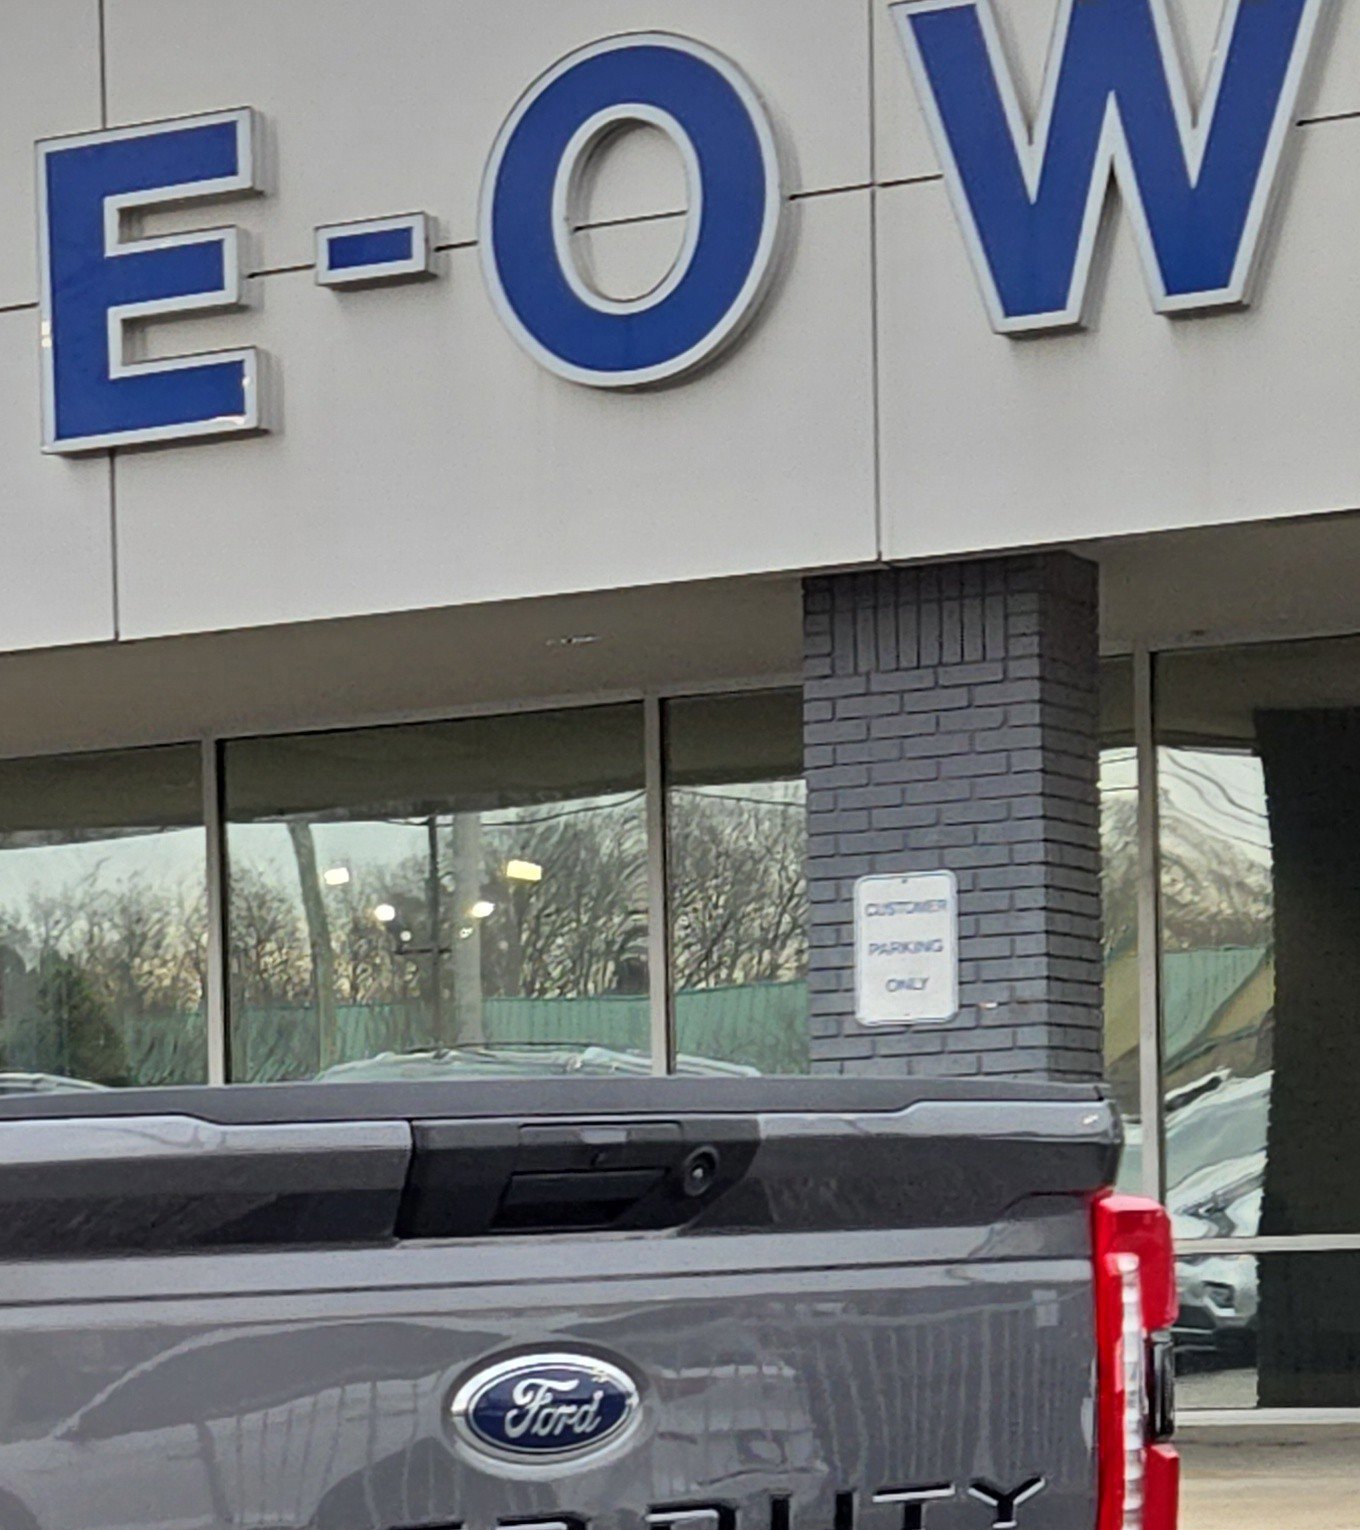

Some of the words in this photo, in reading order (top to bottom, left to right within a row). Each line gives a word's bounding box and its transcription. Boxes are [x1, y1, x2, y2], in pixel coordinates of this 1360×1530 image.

[868, 939, 943, 956] PARKING
[885, 977, 929, 992] ONLY
[504, 1378, 604, 1438] Ford
